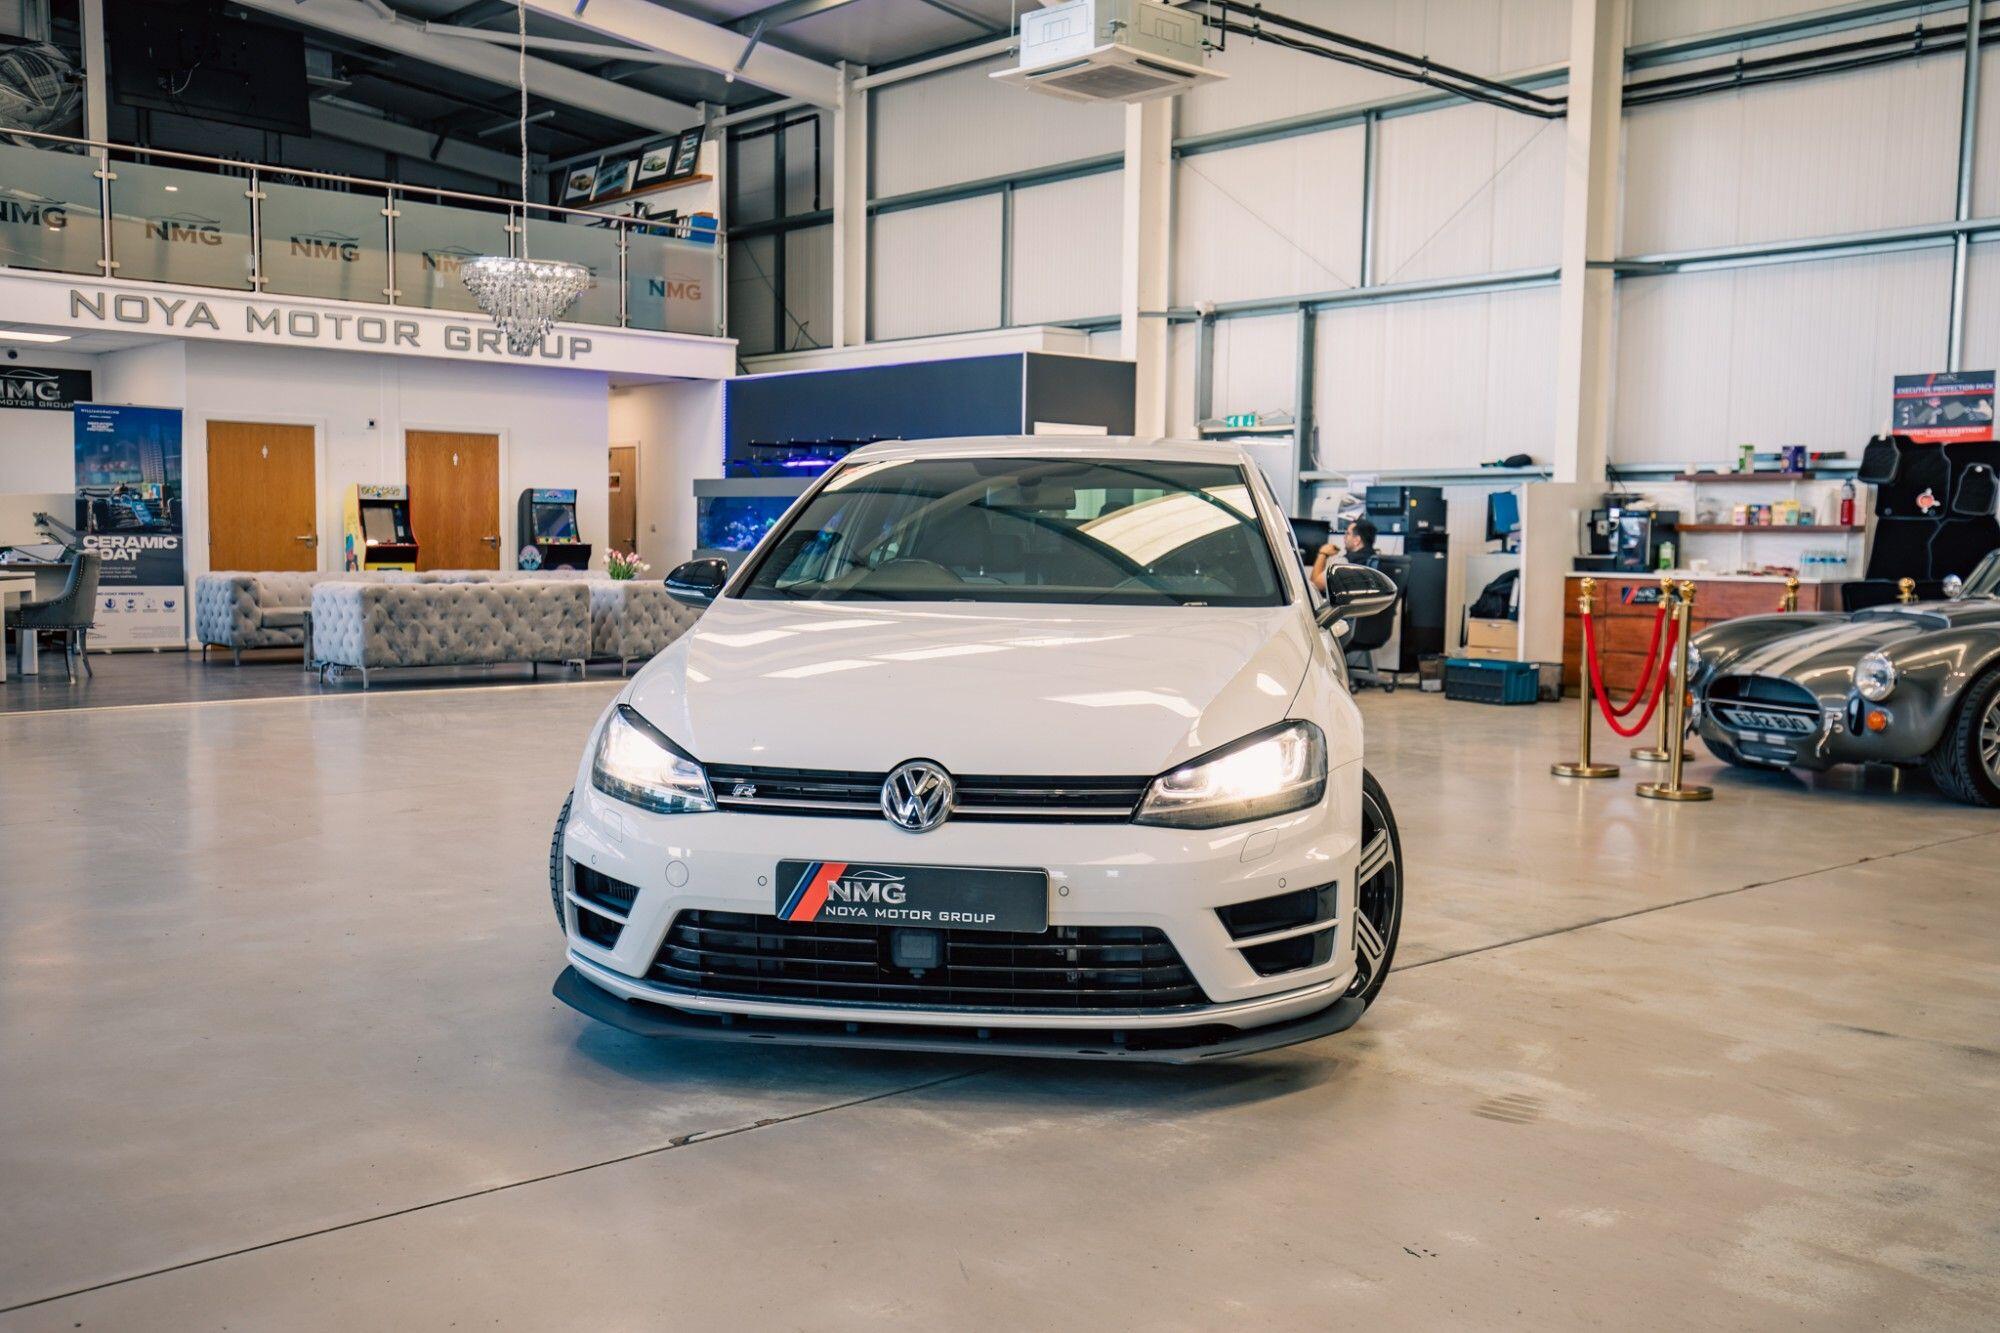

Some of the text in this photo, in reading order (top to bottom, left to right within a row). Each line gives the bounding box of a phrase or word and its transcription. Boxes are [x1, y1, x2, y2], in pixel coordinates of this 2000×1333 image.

[0, 201, 67, 228] MG
[146, 221, 222, 246] NMG
[291, 236, 360, 262] NMG
[649, 279, 702, 300] NMG
[70, 289, 220, 331] NOYA
[246, 305, 421, 347] MOTOR
[0, 379, 61, 400] MG
[1932, 383, 1975, 392] PROTECTION
[1976, 382, 1994, 390] PACK
[83, 535, 178, 550] CERAMIC
[83, 548, 141, 560] OAT
[827, 880, 906, 904] NMG
[825, 906, 996, 923] NOYA MOTOR GROUP
